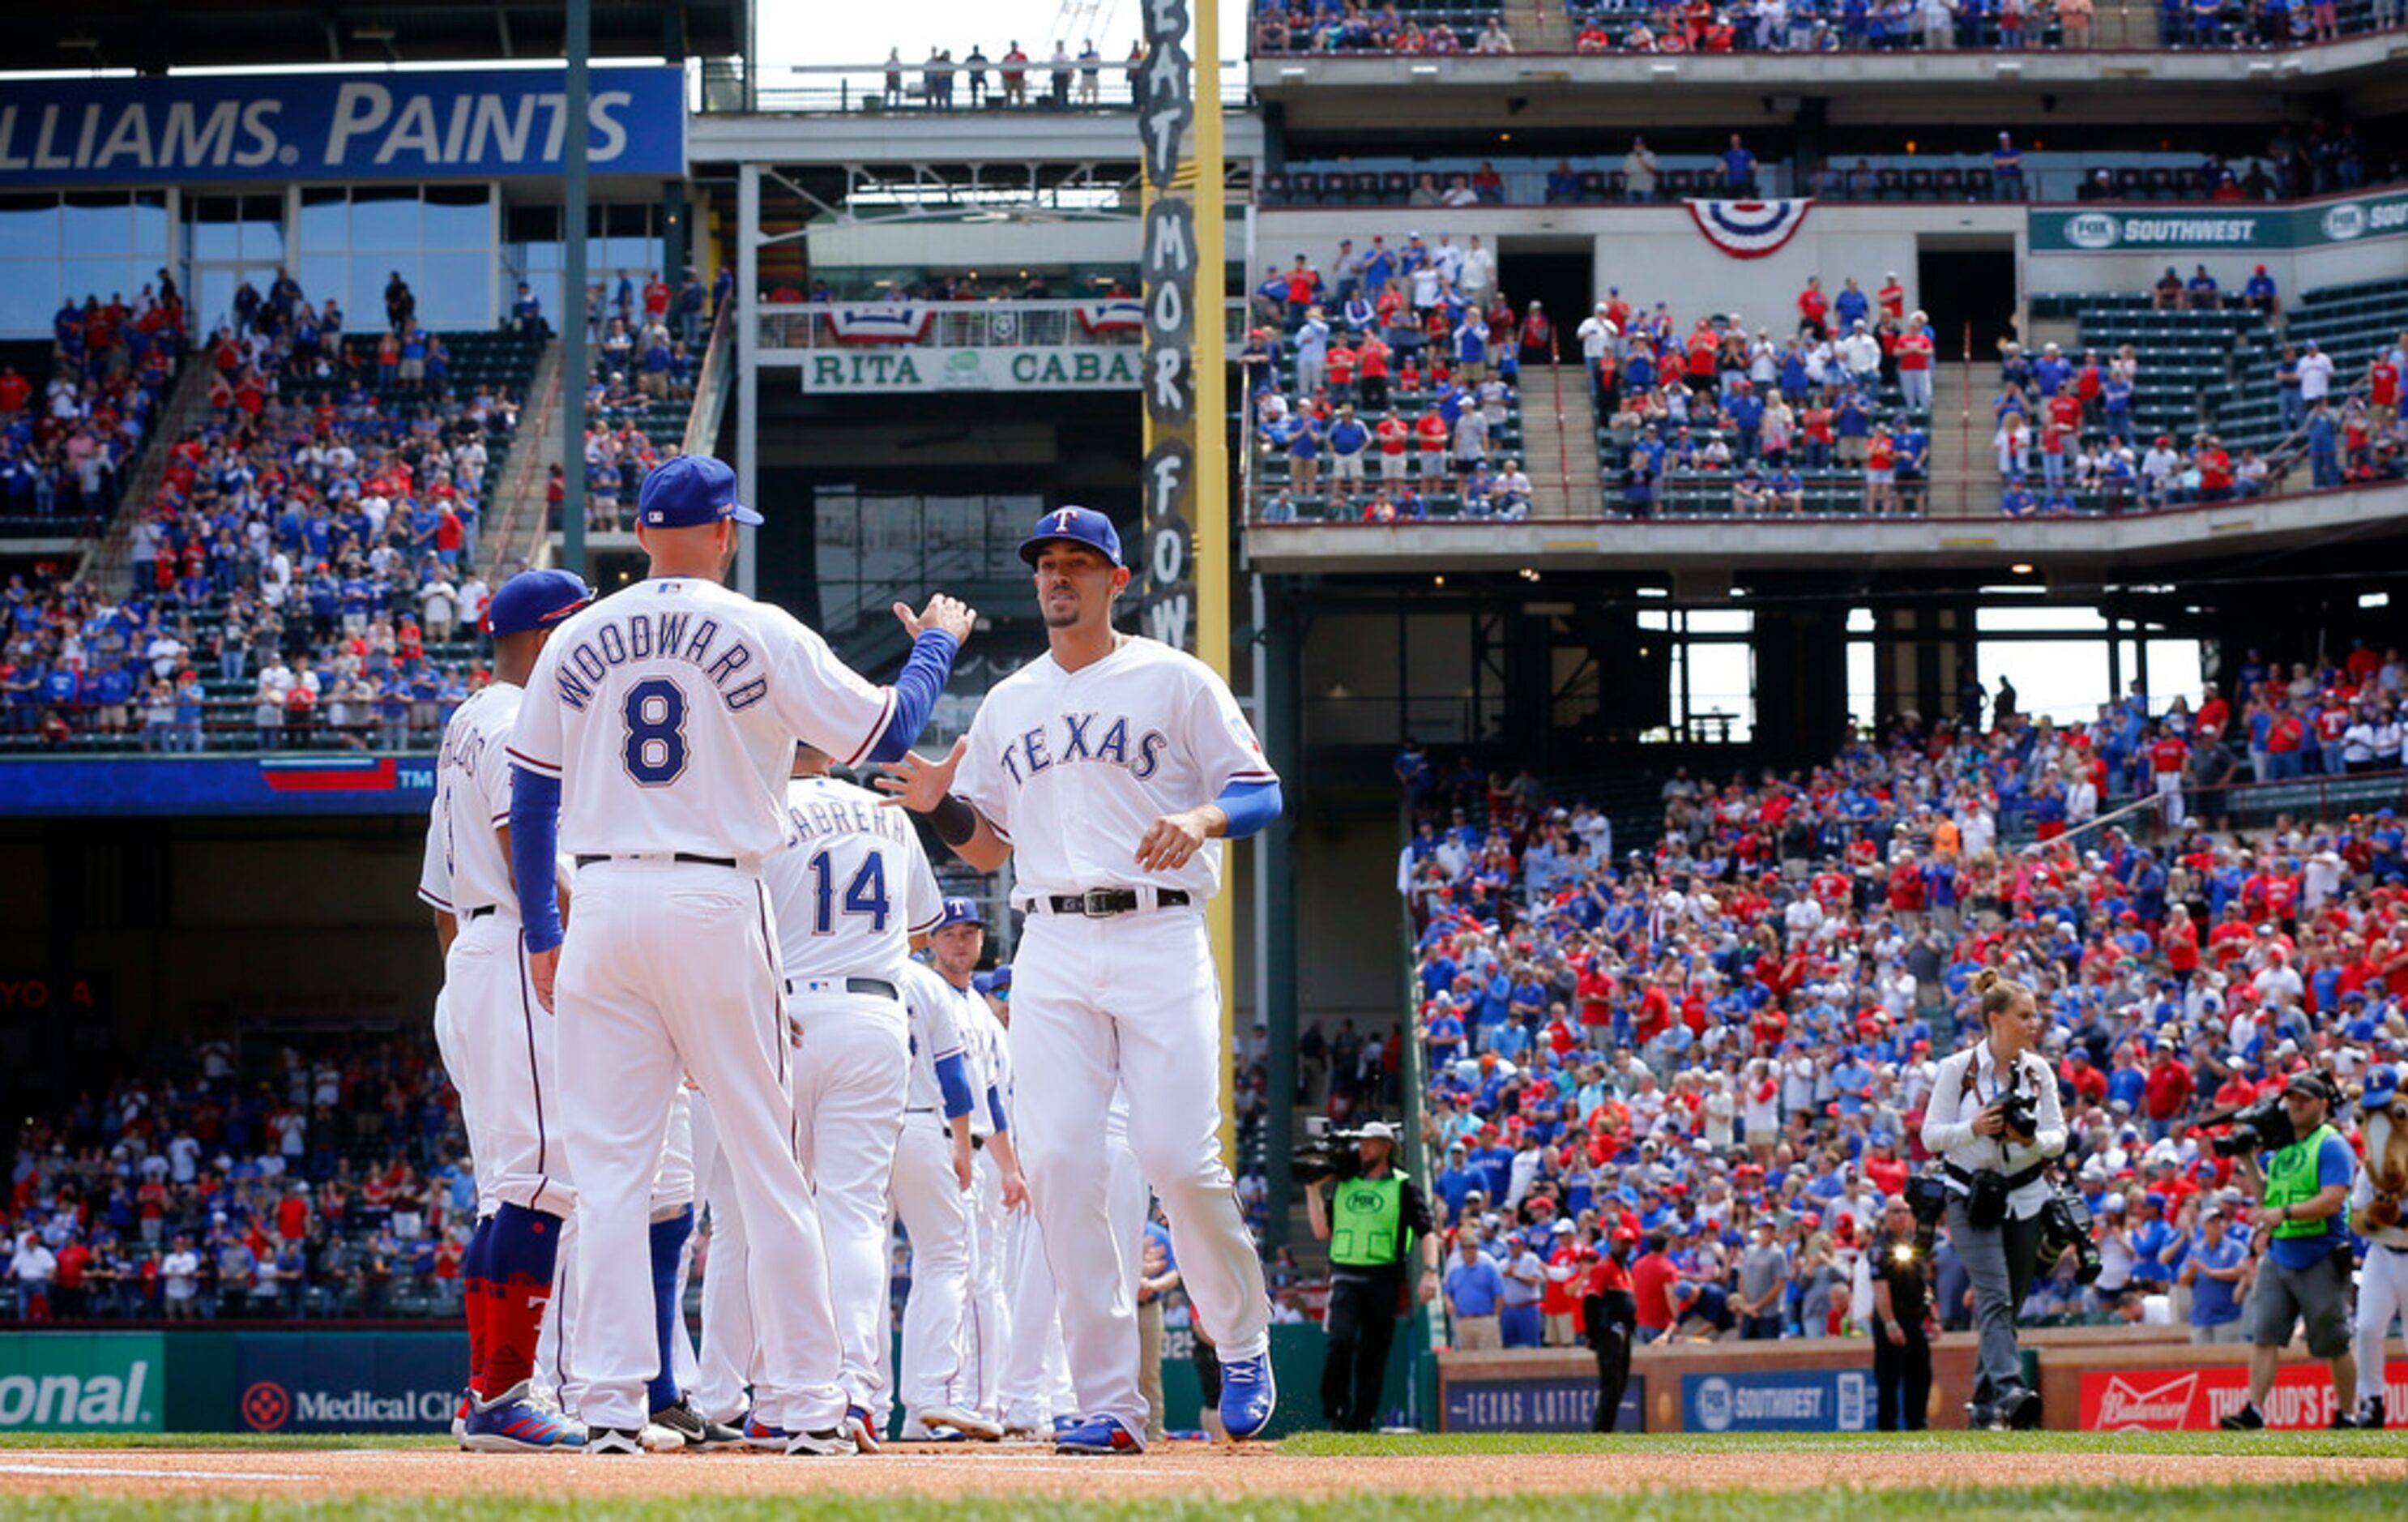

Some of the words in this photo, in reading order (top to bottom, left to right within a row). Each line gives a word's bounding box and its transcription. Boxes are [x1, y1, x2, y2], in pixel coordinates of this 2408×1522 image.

[325, 81, 632, 165] PAINTS
[2124, 219, 2256, 242] SOUTHWEST
[2370, 203, 2408, 229] SOU
[1153, 214, 1189, 410] MOR
[813, 354, 921, 386] RITA
[1011, 353, 1144, 383] CABA
[1053, 510, 1078, 534] T
[556, 611, 767, 713] WOODWARD
[620, 675, 691, 788] 8
[1001, 711, 1167, 786] TEXAS
[399, 772, 433, 788] TM
[809, 849, 891, 935] 14
[949, 901, 965, 916] T
[2367, 1071, 2384, 1088] T
[297, 1392, 415, 1422] Medical
[1467, 1392, 1522, 1424] TEXAS
[2102, 1390, 2188, 1424] Budweiser
